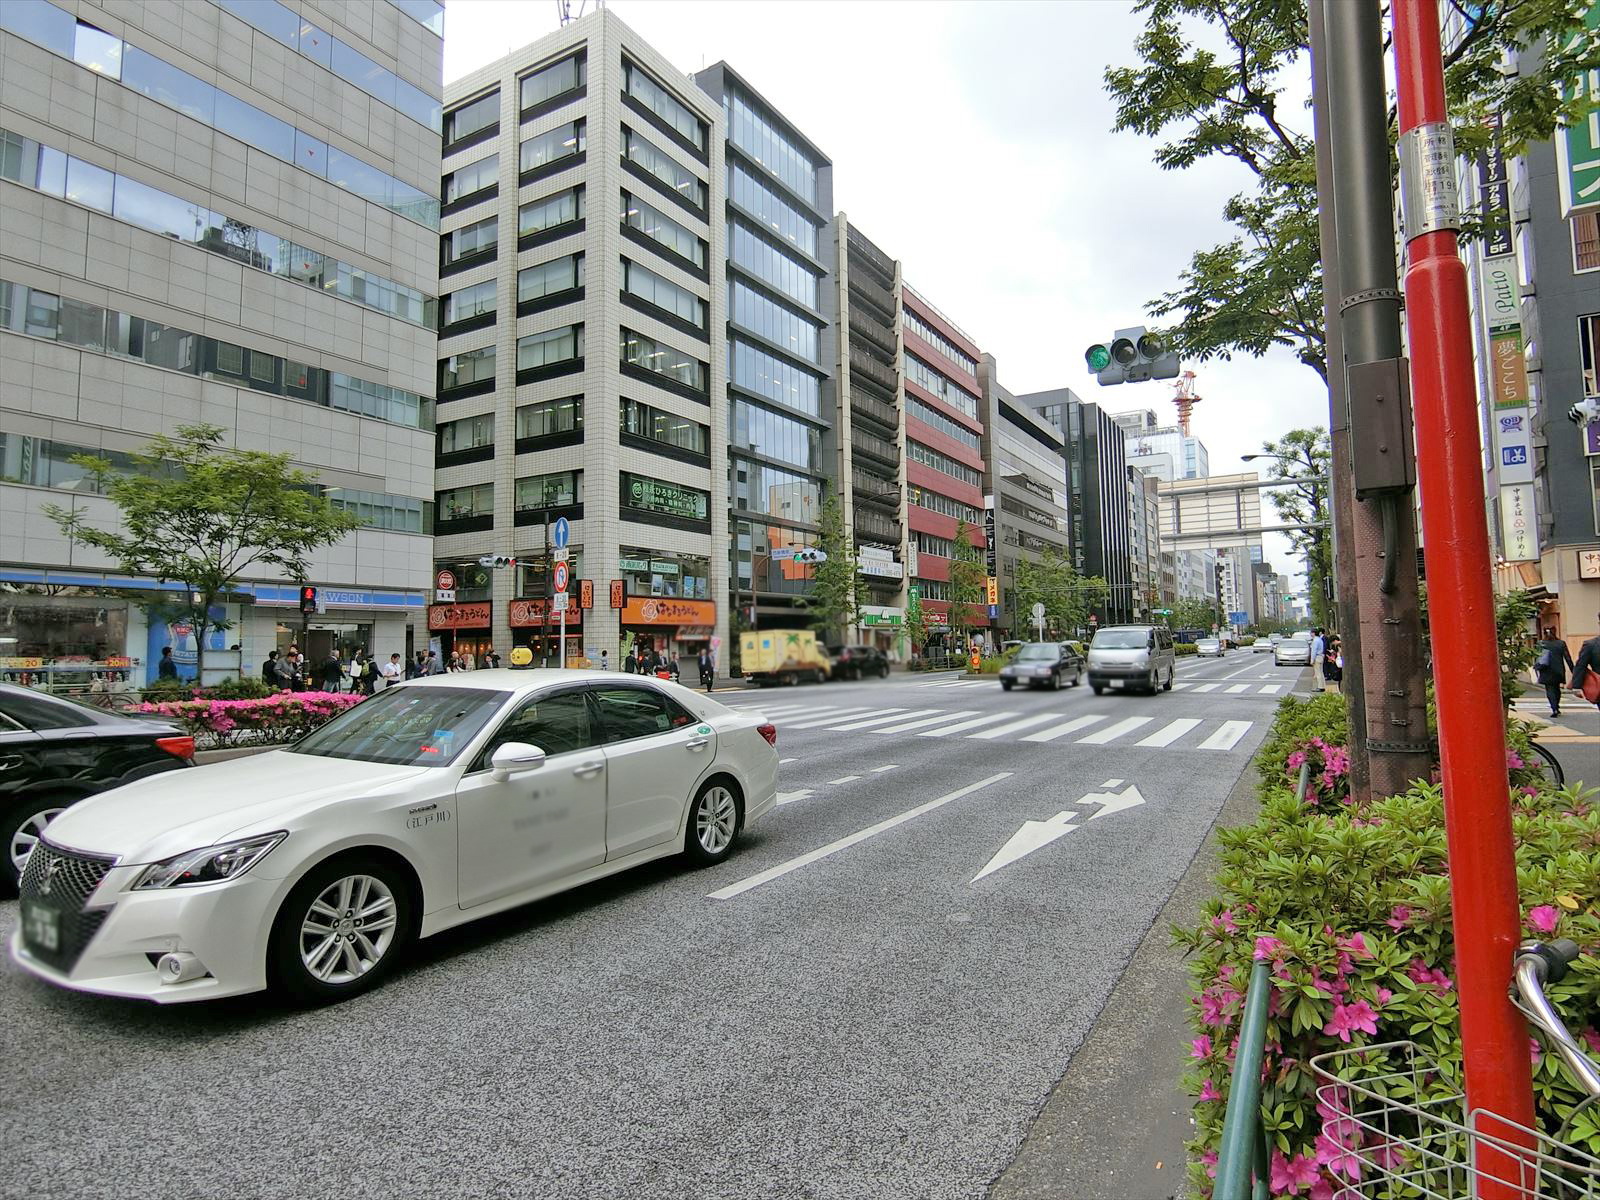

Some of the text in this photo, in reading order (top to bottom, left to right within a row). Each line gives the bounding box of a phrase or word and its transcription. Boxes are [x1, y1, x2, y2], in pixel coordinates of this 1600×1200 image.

[1490, 243, 1508, 254] 5F
[1513, 487, 1526, 558] 中華そば つけめん
[1587, 566, 1600, 574] つ
[316, 591, 365, 603] AWSON
[656, 601, 699, 617] はなまるうどん
